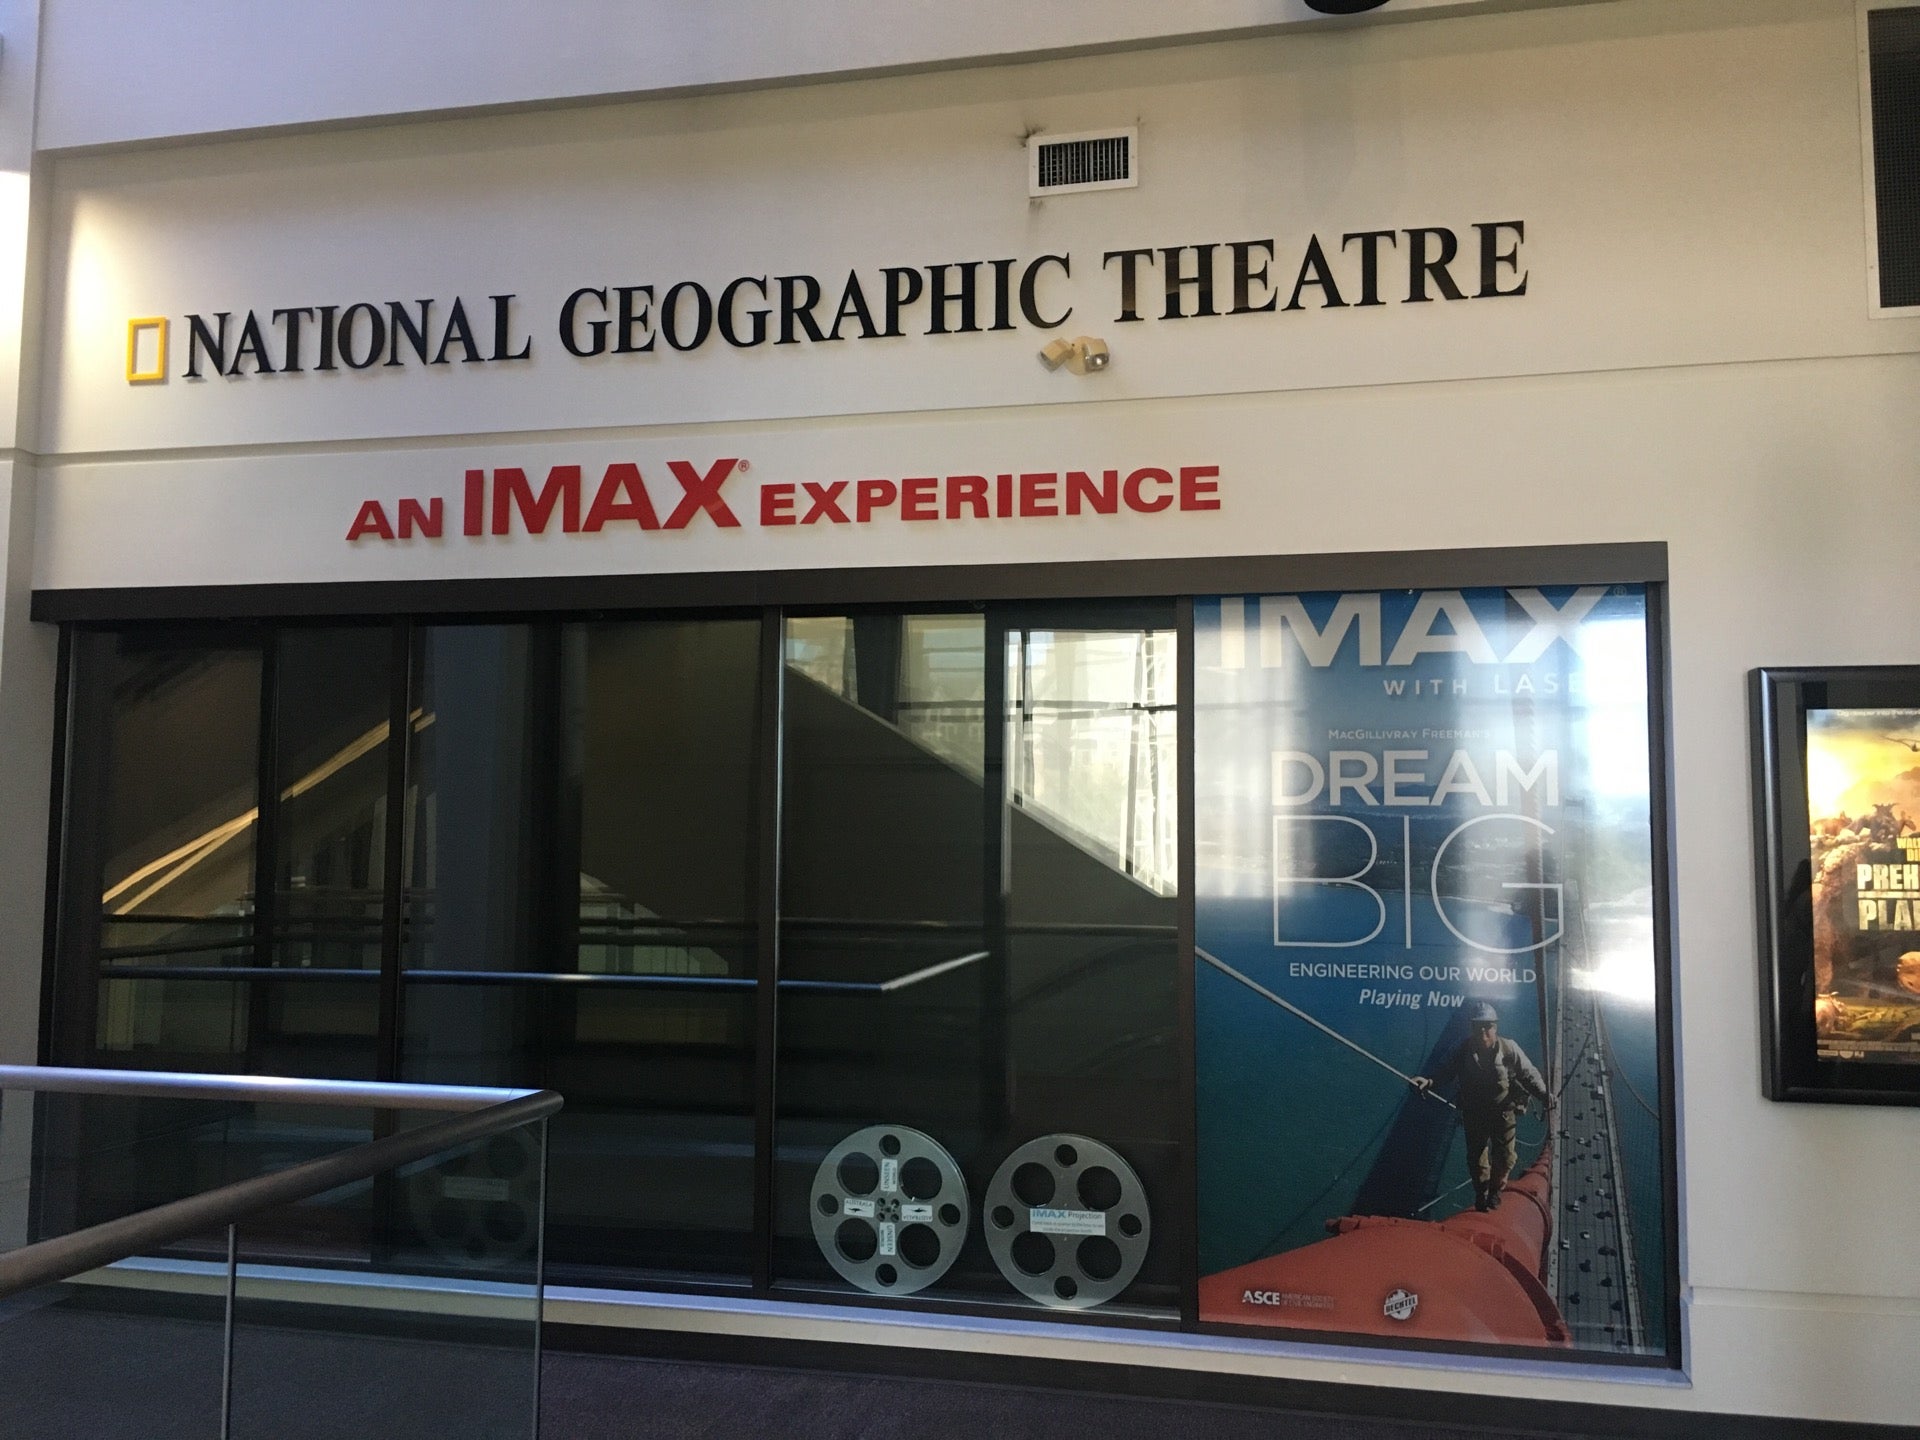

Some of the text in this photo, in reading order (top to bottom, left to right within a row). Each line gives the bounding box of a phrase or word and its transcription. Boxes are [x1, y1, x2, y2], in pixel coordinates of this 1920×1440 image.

[183, 221, 1528, 378] NATIONAL GEOGRAPHIC THEATRE
[346, 498, 443, 541] AN
[760, 465, 1221, 527] EXPERIENCE
[1383, 677, 1468, 696] WITH
[1271, 749, 1560, 807] DREAM
[1272, 813, 1565, 955] BIG
[1289, 962, 1537, 984] ENGINEERING OUR WORLD
[1359, 988, 1464, 1010] Playing Now
[1032, 1209, 1103, 1221] IMAX Projection
[1242, 1290, 1281, 1306] ASCE
